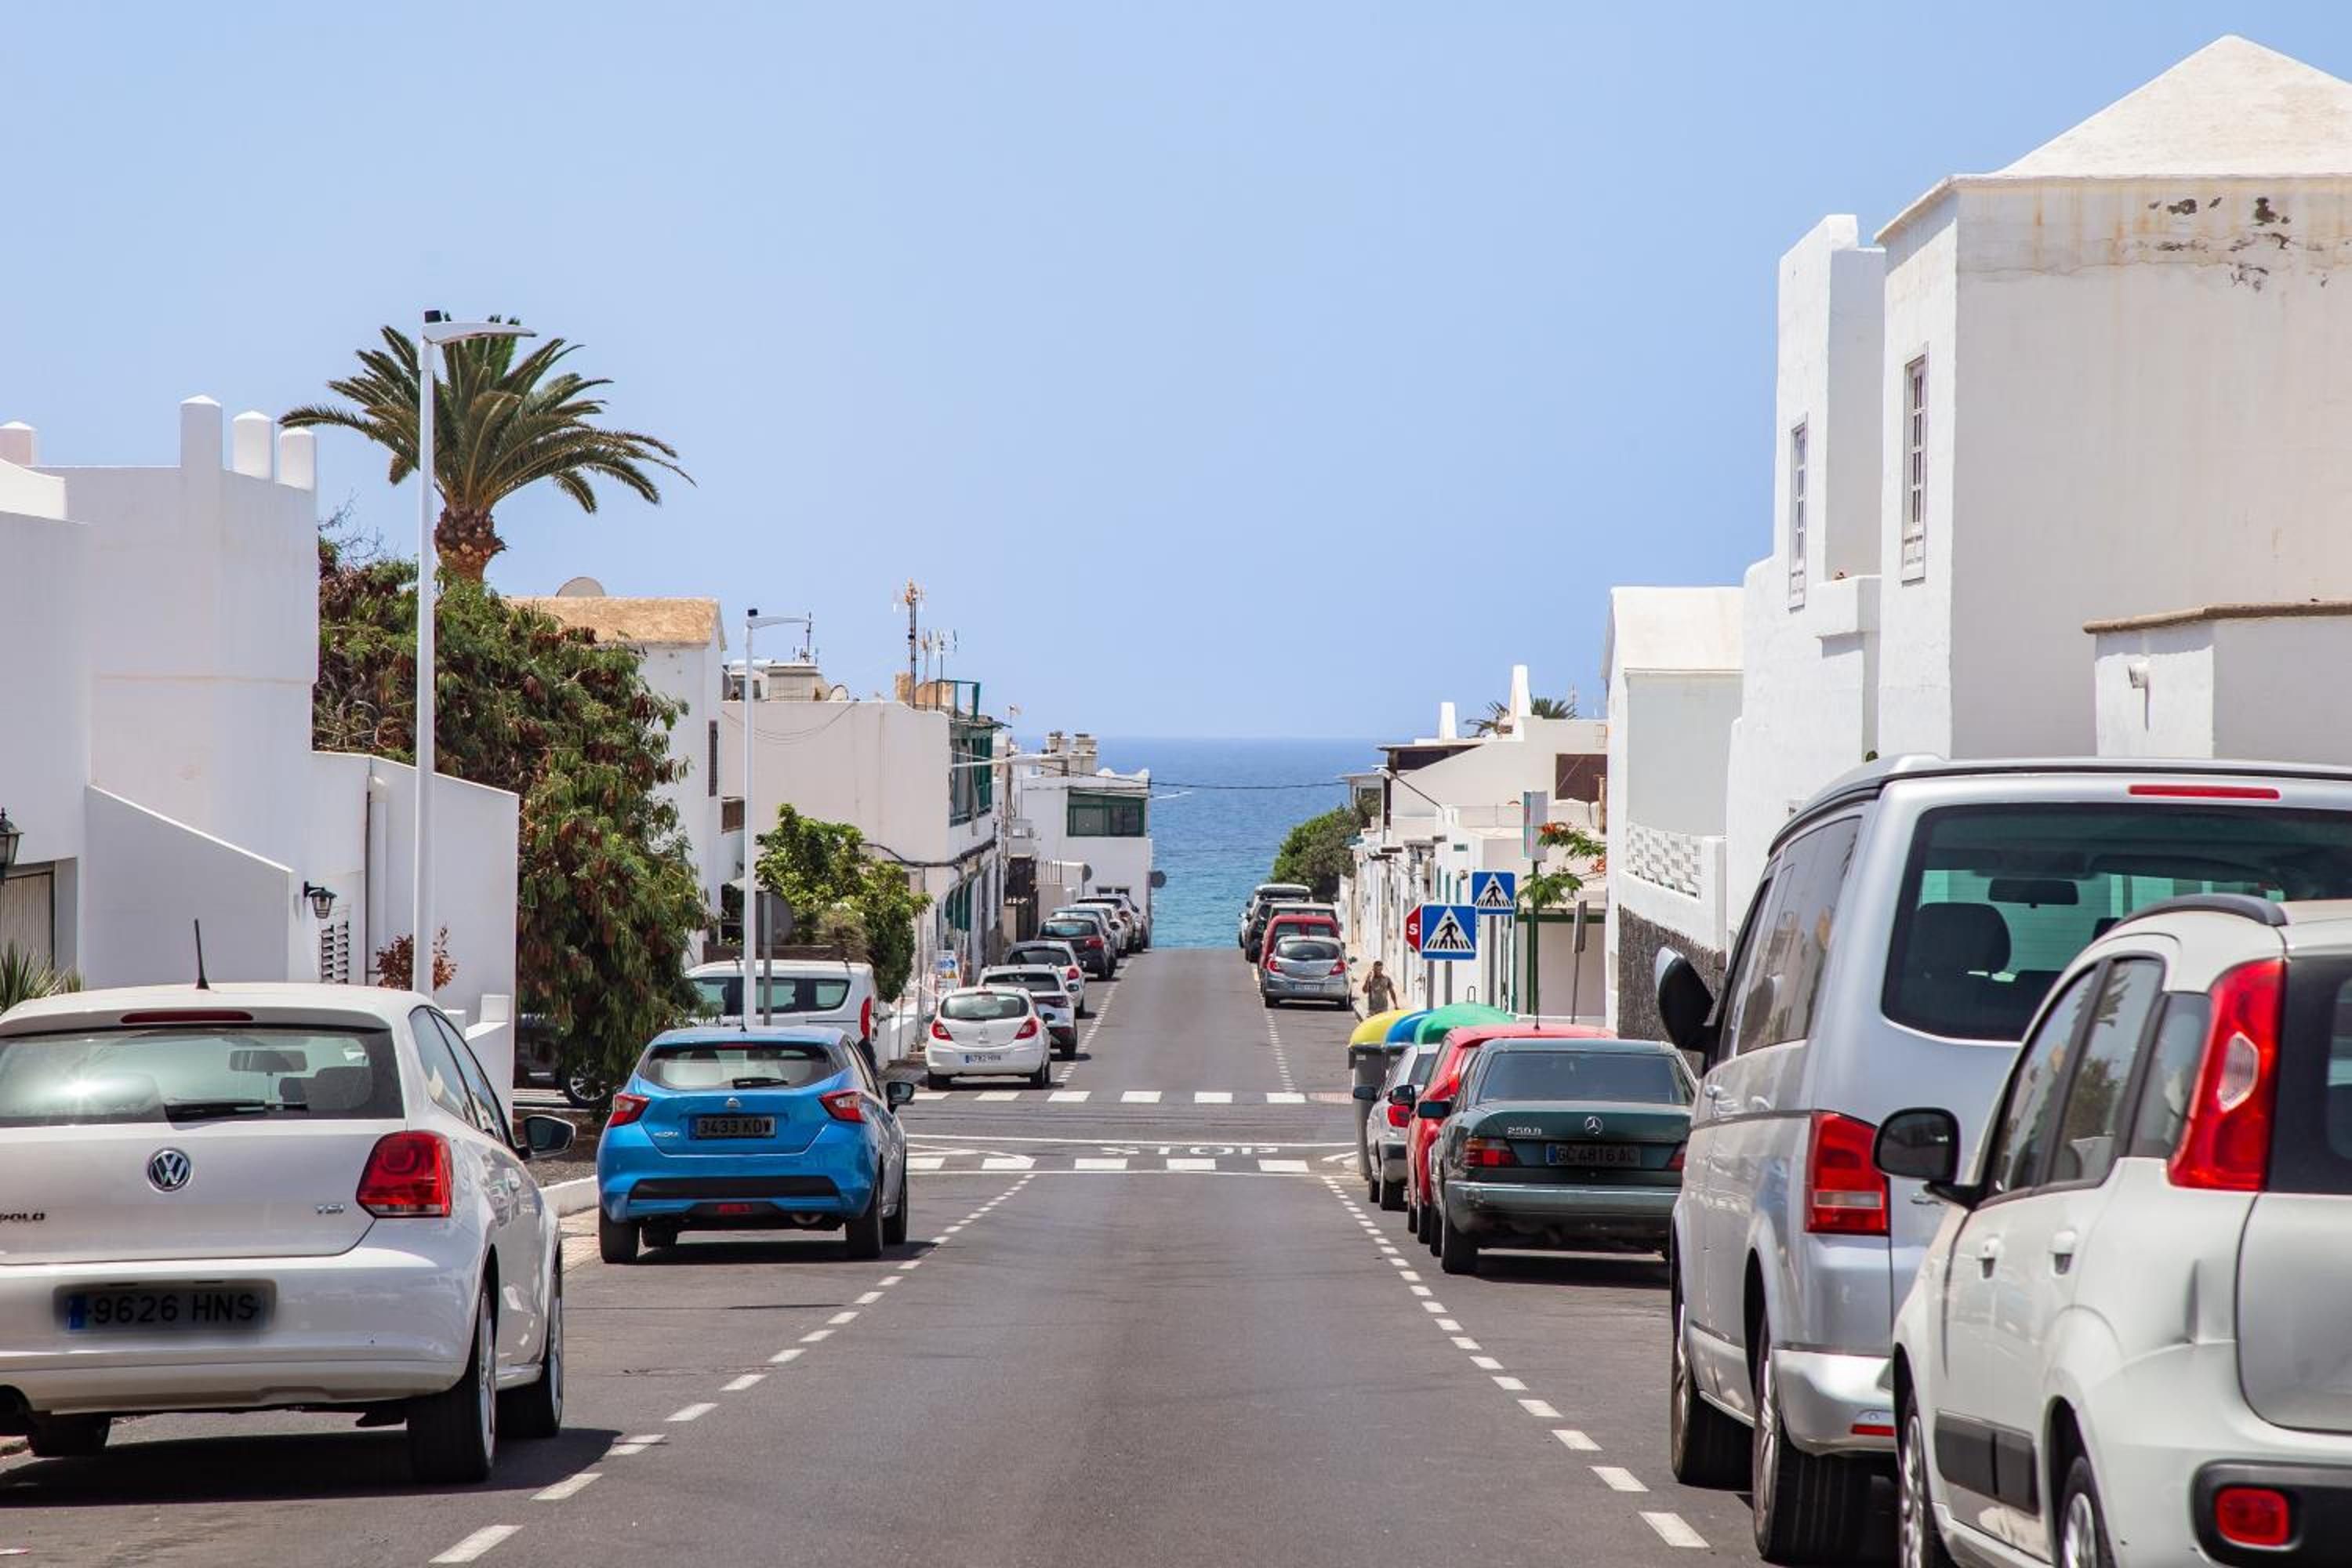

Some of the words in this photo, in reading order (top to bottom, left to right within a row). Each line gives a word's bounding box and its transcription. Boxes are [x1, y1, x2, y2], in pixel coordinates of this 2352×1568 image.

[1100, 1146, 1279, 1155] STOP
[93, 1295, 179, 1324] 9626
[192, 1294, 255, 1322] HNS
